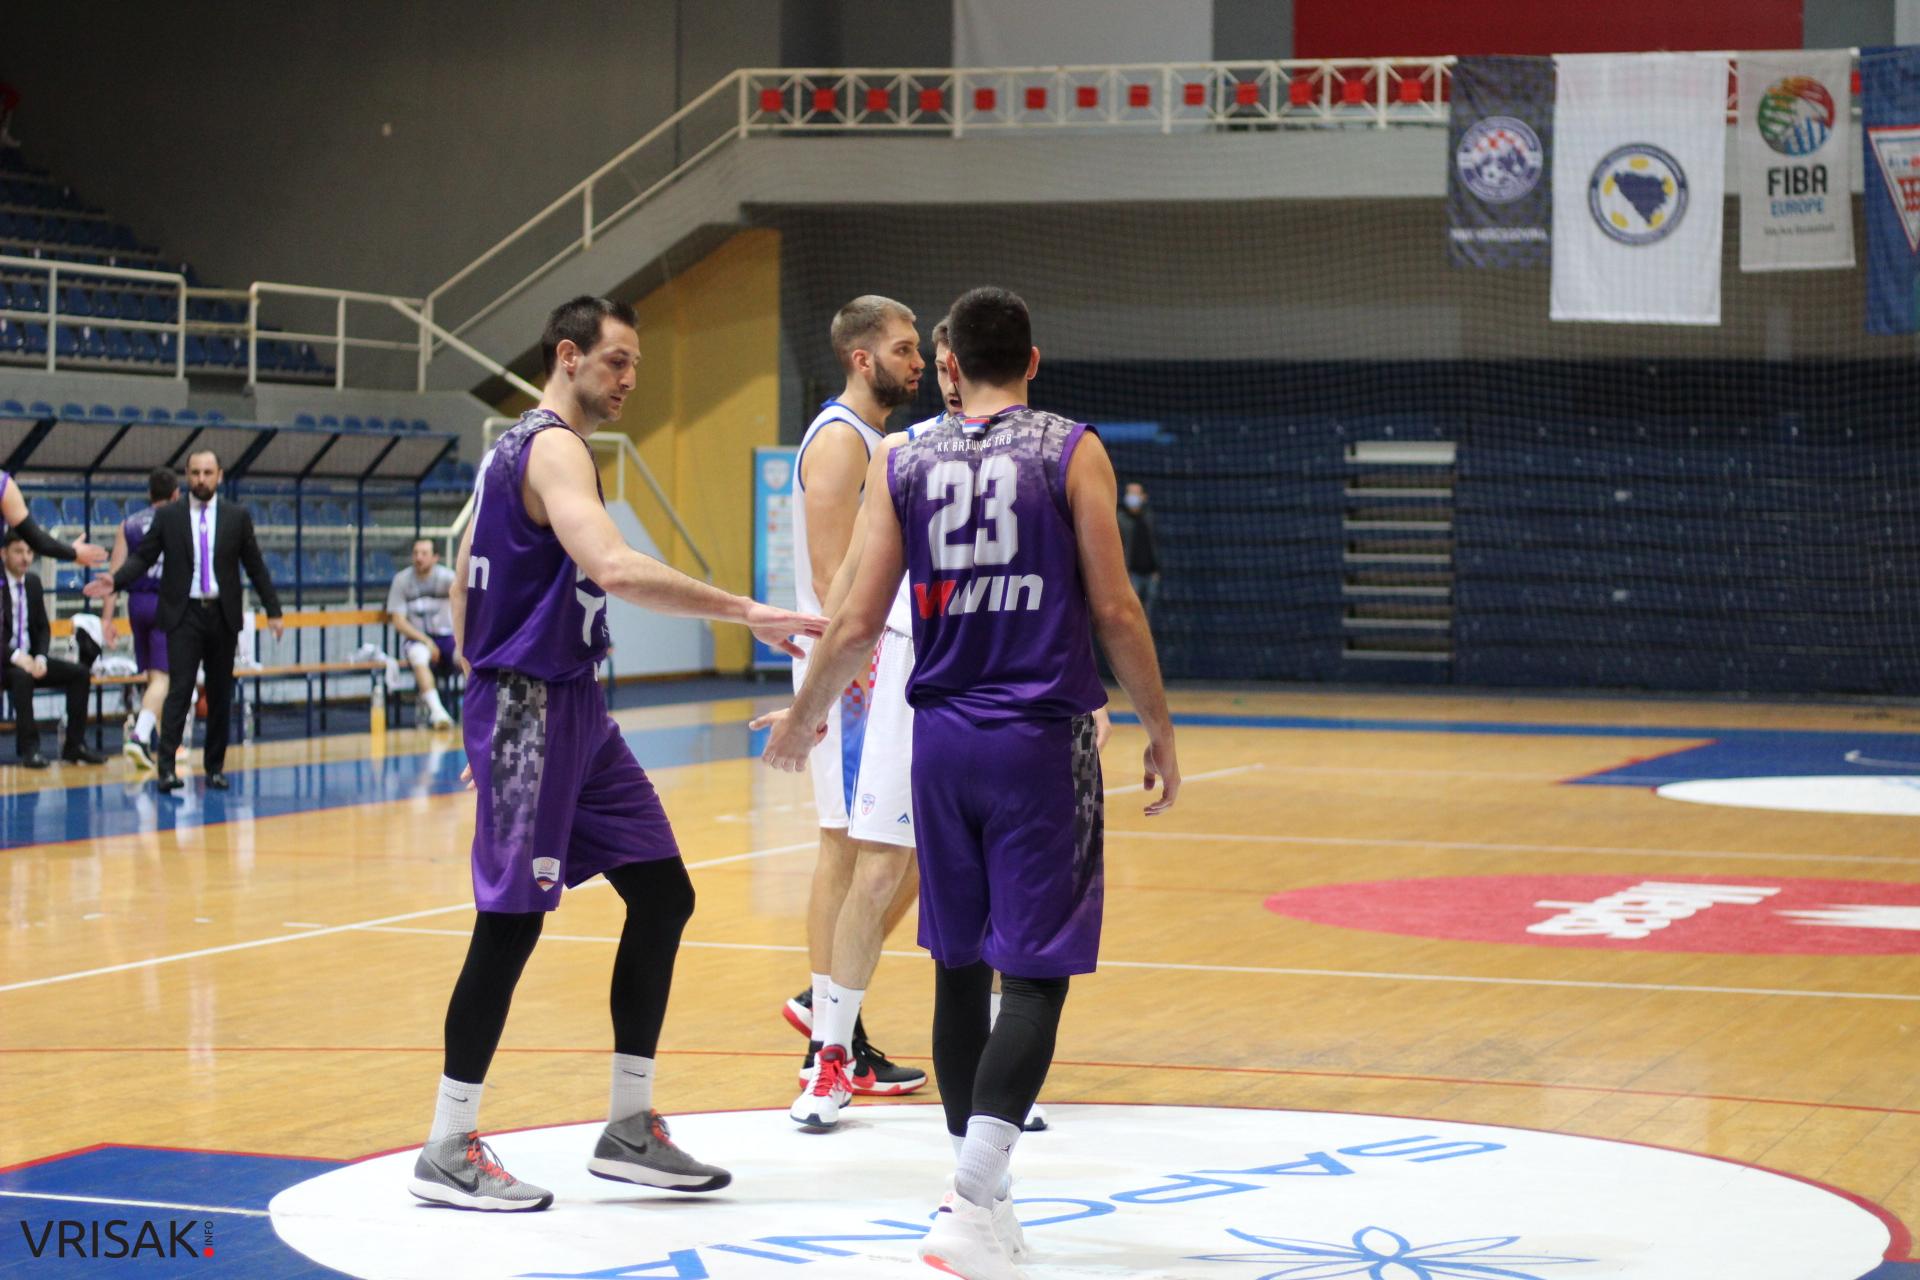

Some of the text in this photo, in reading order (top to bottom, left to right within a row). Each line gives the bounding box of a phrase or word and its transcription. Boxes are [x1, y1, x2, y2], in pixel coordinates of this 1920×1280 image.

[1767, 164, 1828, 196] FIBA
[1770, 197, 1825, 218] EUROPE
[937, 441, 949, 452] KK
[994, 433, 1012, 446] TRB
[927, 454, 1018, 570] 23
